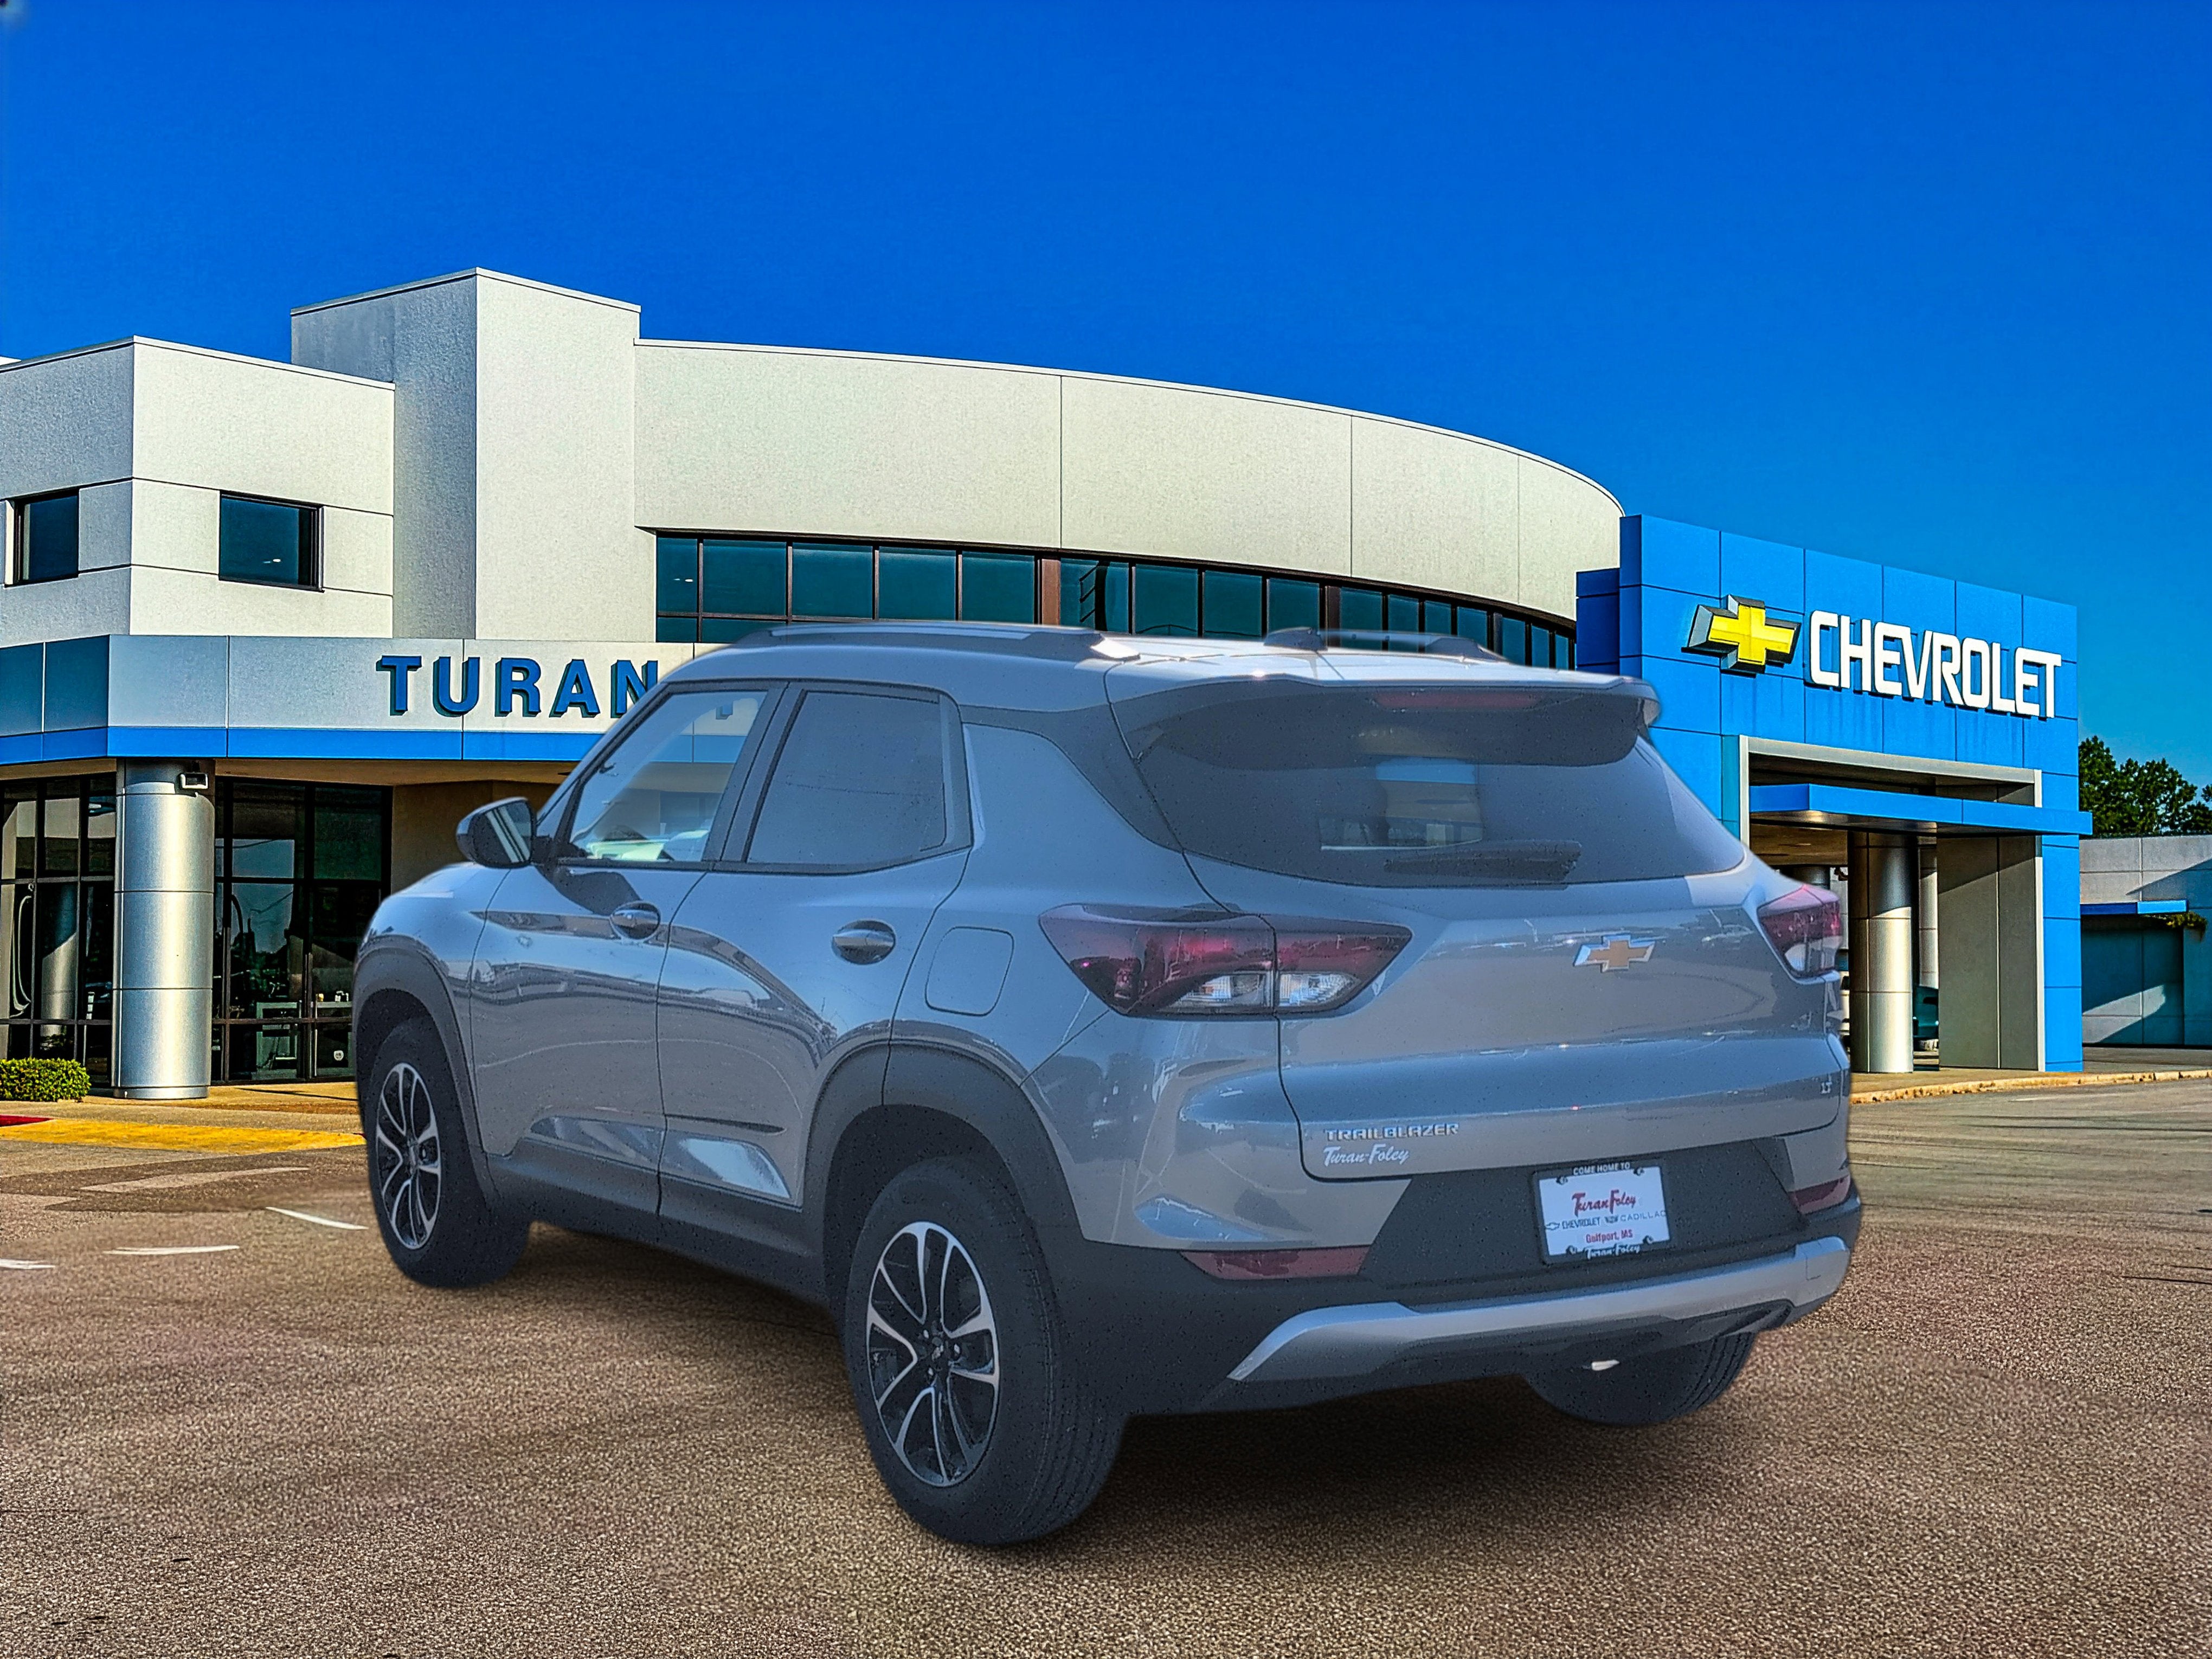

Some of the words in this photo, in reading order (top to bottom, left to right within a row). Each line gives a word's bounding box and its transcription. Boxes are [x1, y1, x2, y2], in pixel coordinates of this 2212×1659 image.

[1810, 609, 2062, 719] CHEVROLET
[376, 655, 658, 718] TURAN
[1324, 1123, 1459, 1141] TRAILBLAZER
[1573, 1166, 1596, 1175] COME
[1597, 1163, 1619, 1173] HOME
[1621, 1161, 1630, 1169] TO
[1561, 1217, 1600, 1230] CHEVROLET
[1619, 1209, 1667, 1222] CADILLAC
[1621, 1229, 1633, 1239] MS
